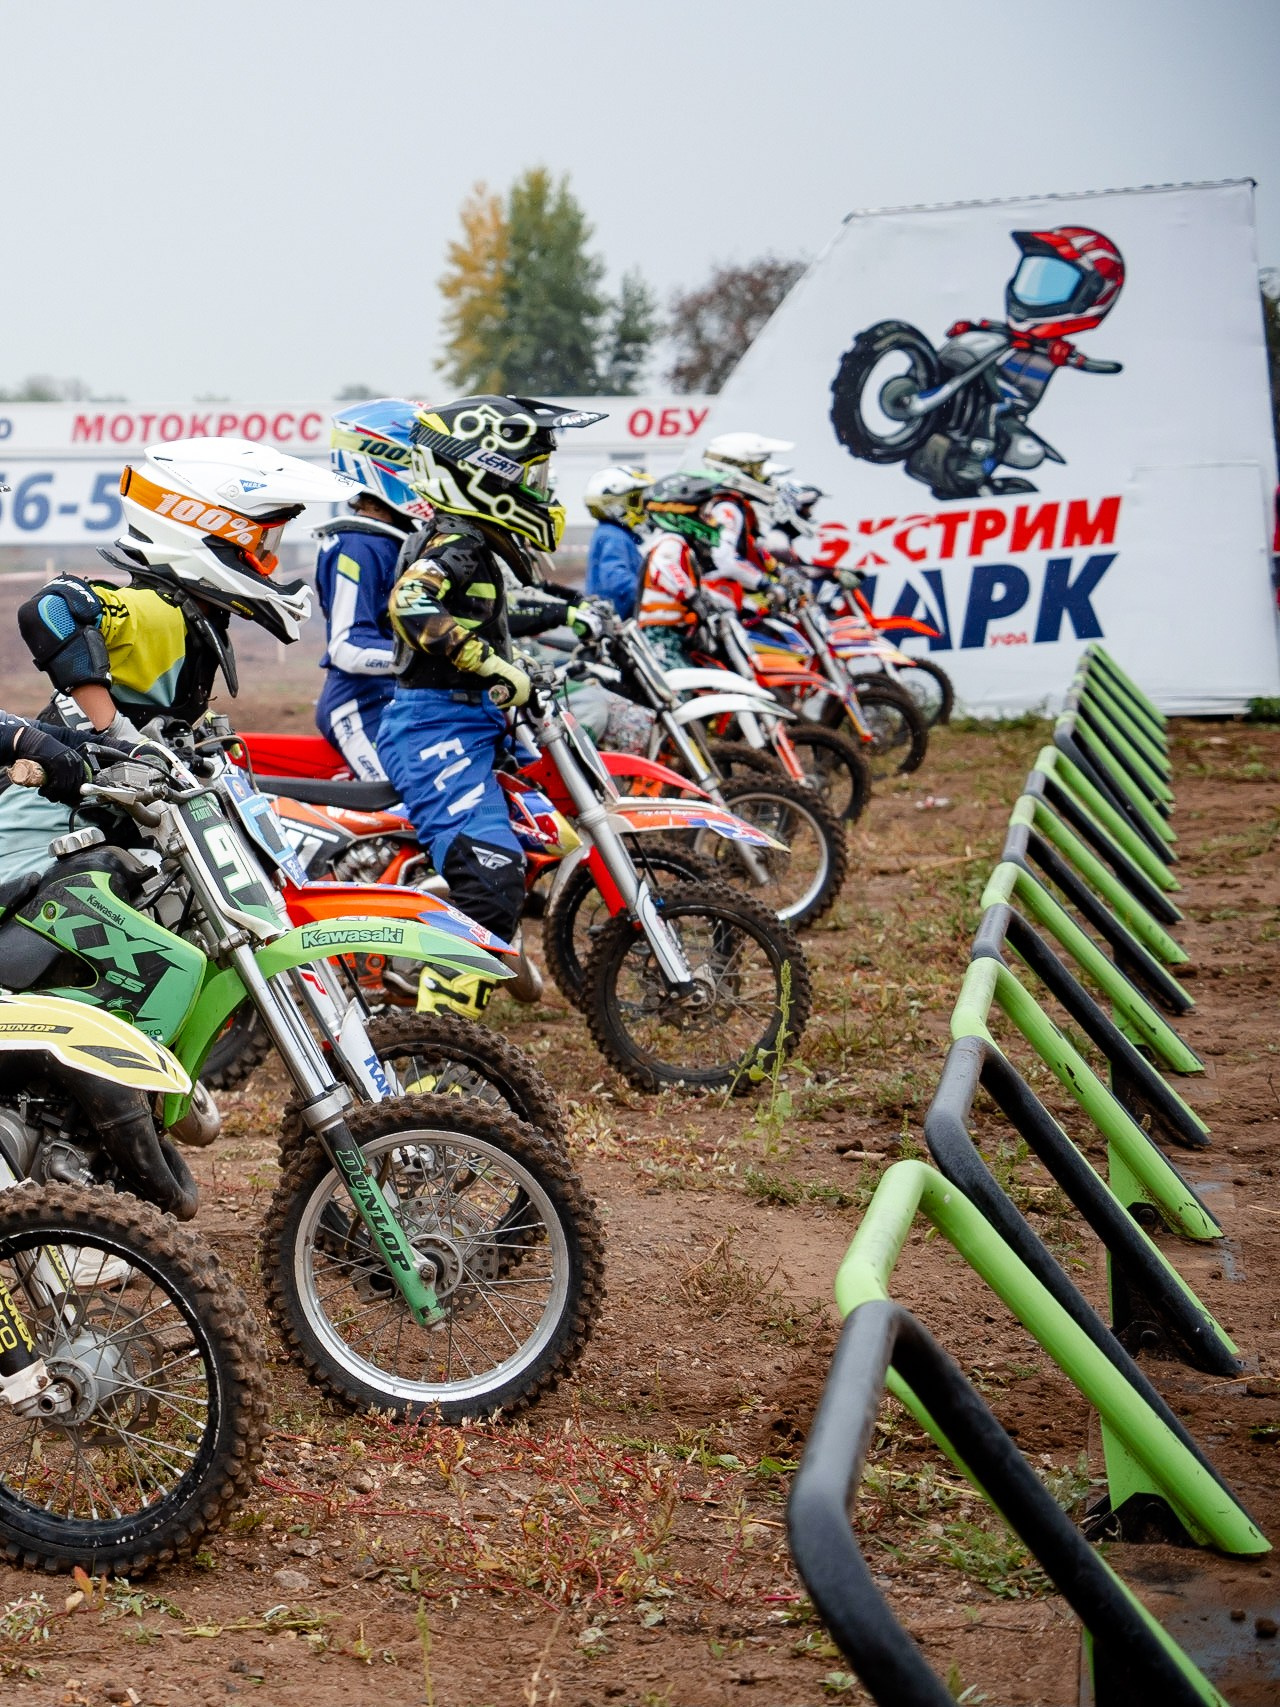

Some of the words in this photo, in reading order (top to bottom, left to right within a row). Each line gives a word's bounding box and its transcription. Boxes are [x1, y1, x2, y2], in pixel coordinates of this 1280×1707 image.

[72, 412, 323, 443] МОТОКРОСС
[627, 409, 709, 437] ОБУ
[154, 493, 260, 546] 100%
[812, 495, 1123, 568] ЭКСТРИМ
[420, 737, 485, 817] FLY
[86, 894, 126, 926] Kawasaki
[301, 927, 404, 949] Kawasaki
[104, 970, 146, 993] 65
[336, 1150, 412, 1272] DUNLOP
